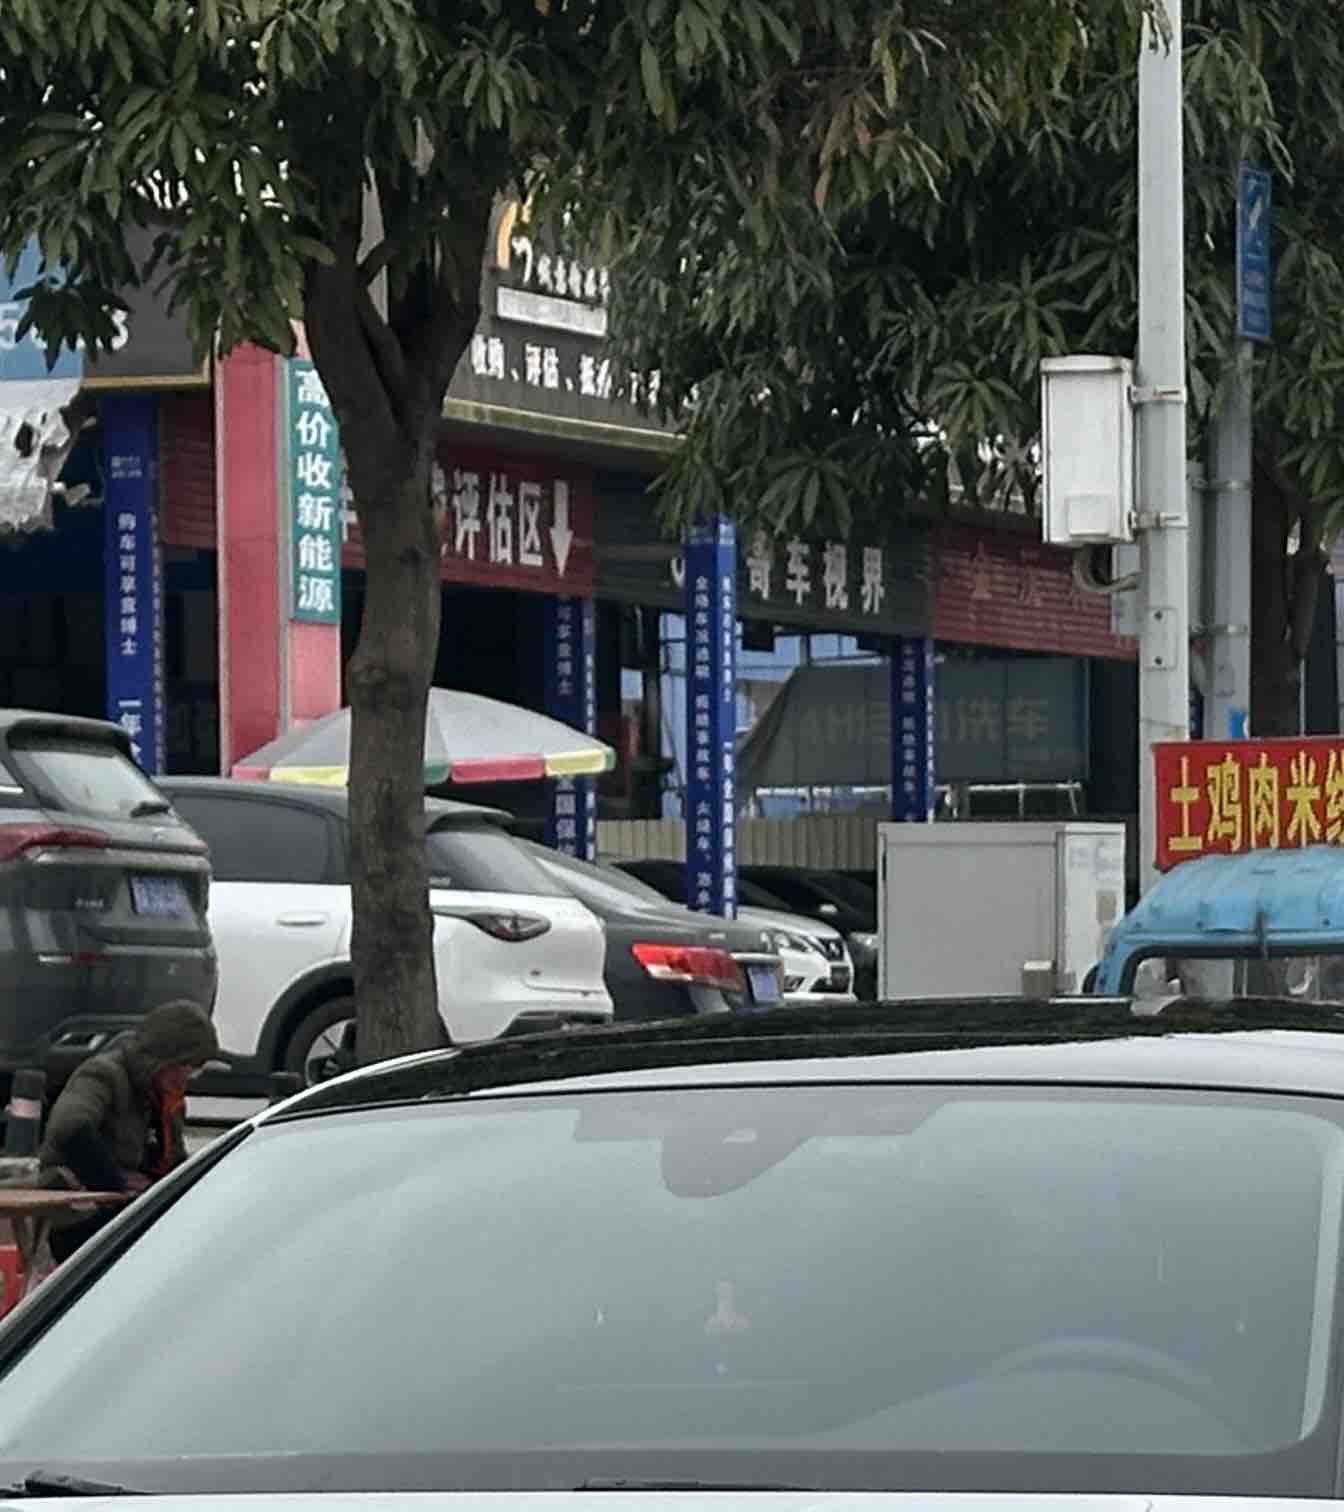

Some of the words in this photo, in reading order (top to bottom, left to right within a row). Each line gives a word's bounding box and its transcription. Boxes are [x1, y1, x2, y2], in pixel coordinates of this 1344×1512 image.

[294, 367, 334, 612] 高价收新能源
